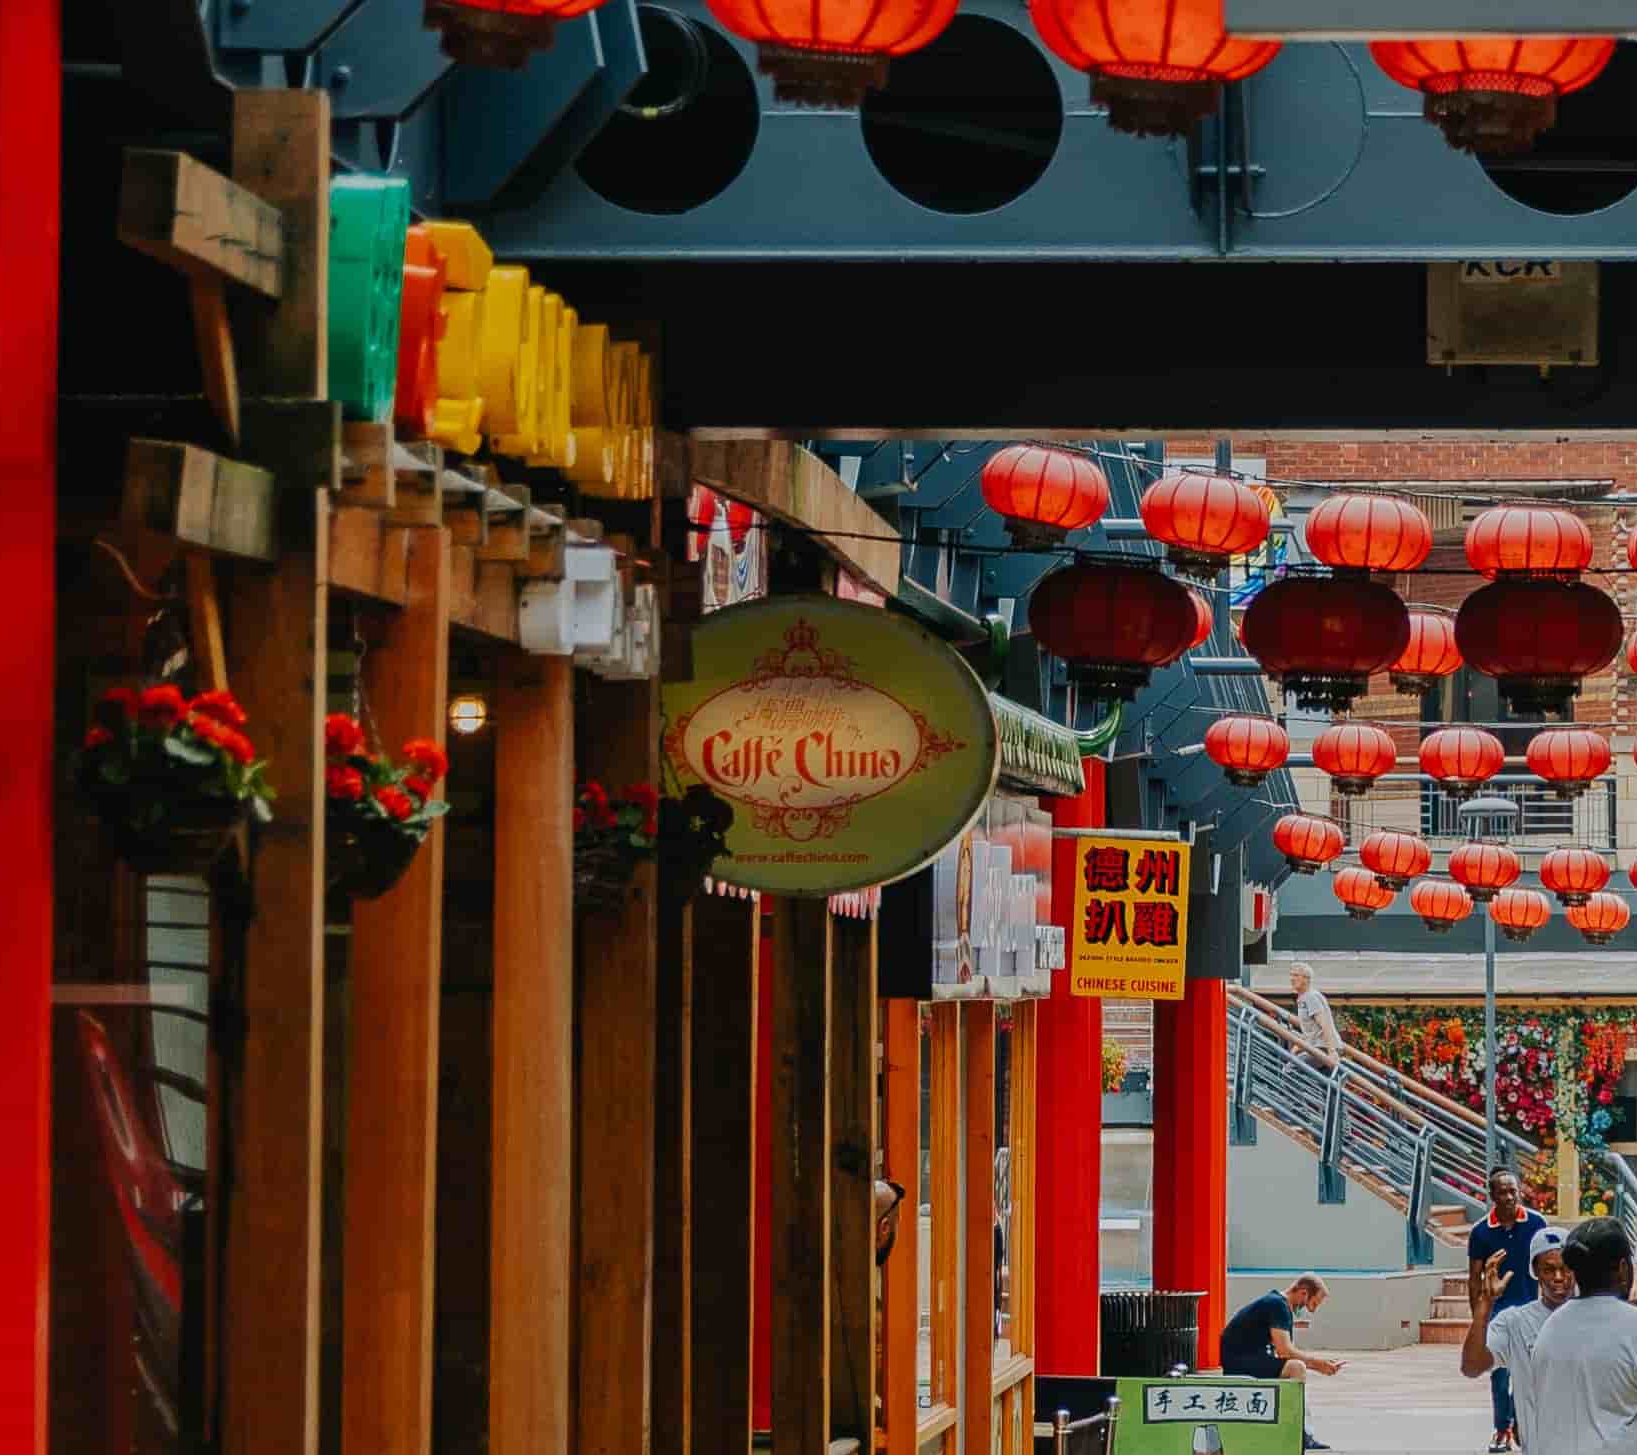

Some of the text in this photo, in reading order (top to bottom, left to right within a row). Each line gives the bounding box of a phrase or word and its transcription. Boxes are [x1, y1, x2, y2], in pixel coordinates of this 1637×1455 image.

[702, 729, 902, 790] Caffé Chino
[1083, 845, 1181, 897] 德州
[1076, 976, 1178, 994] CHINESE CUISINE
[1153, 1389, 1269, 1416] 手工拉面
